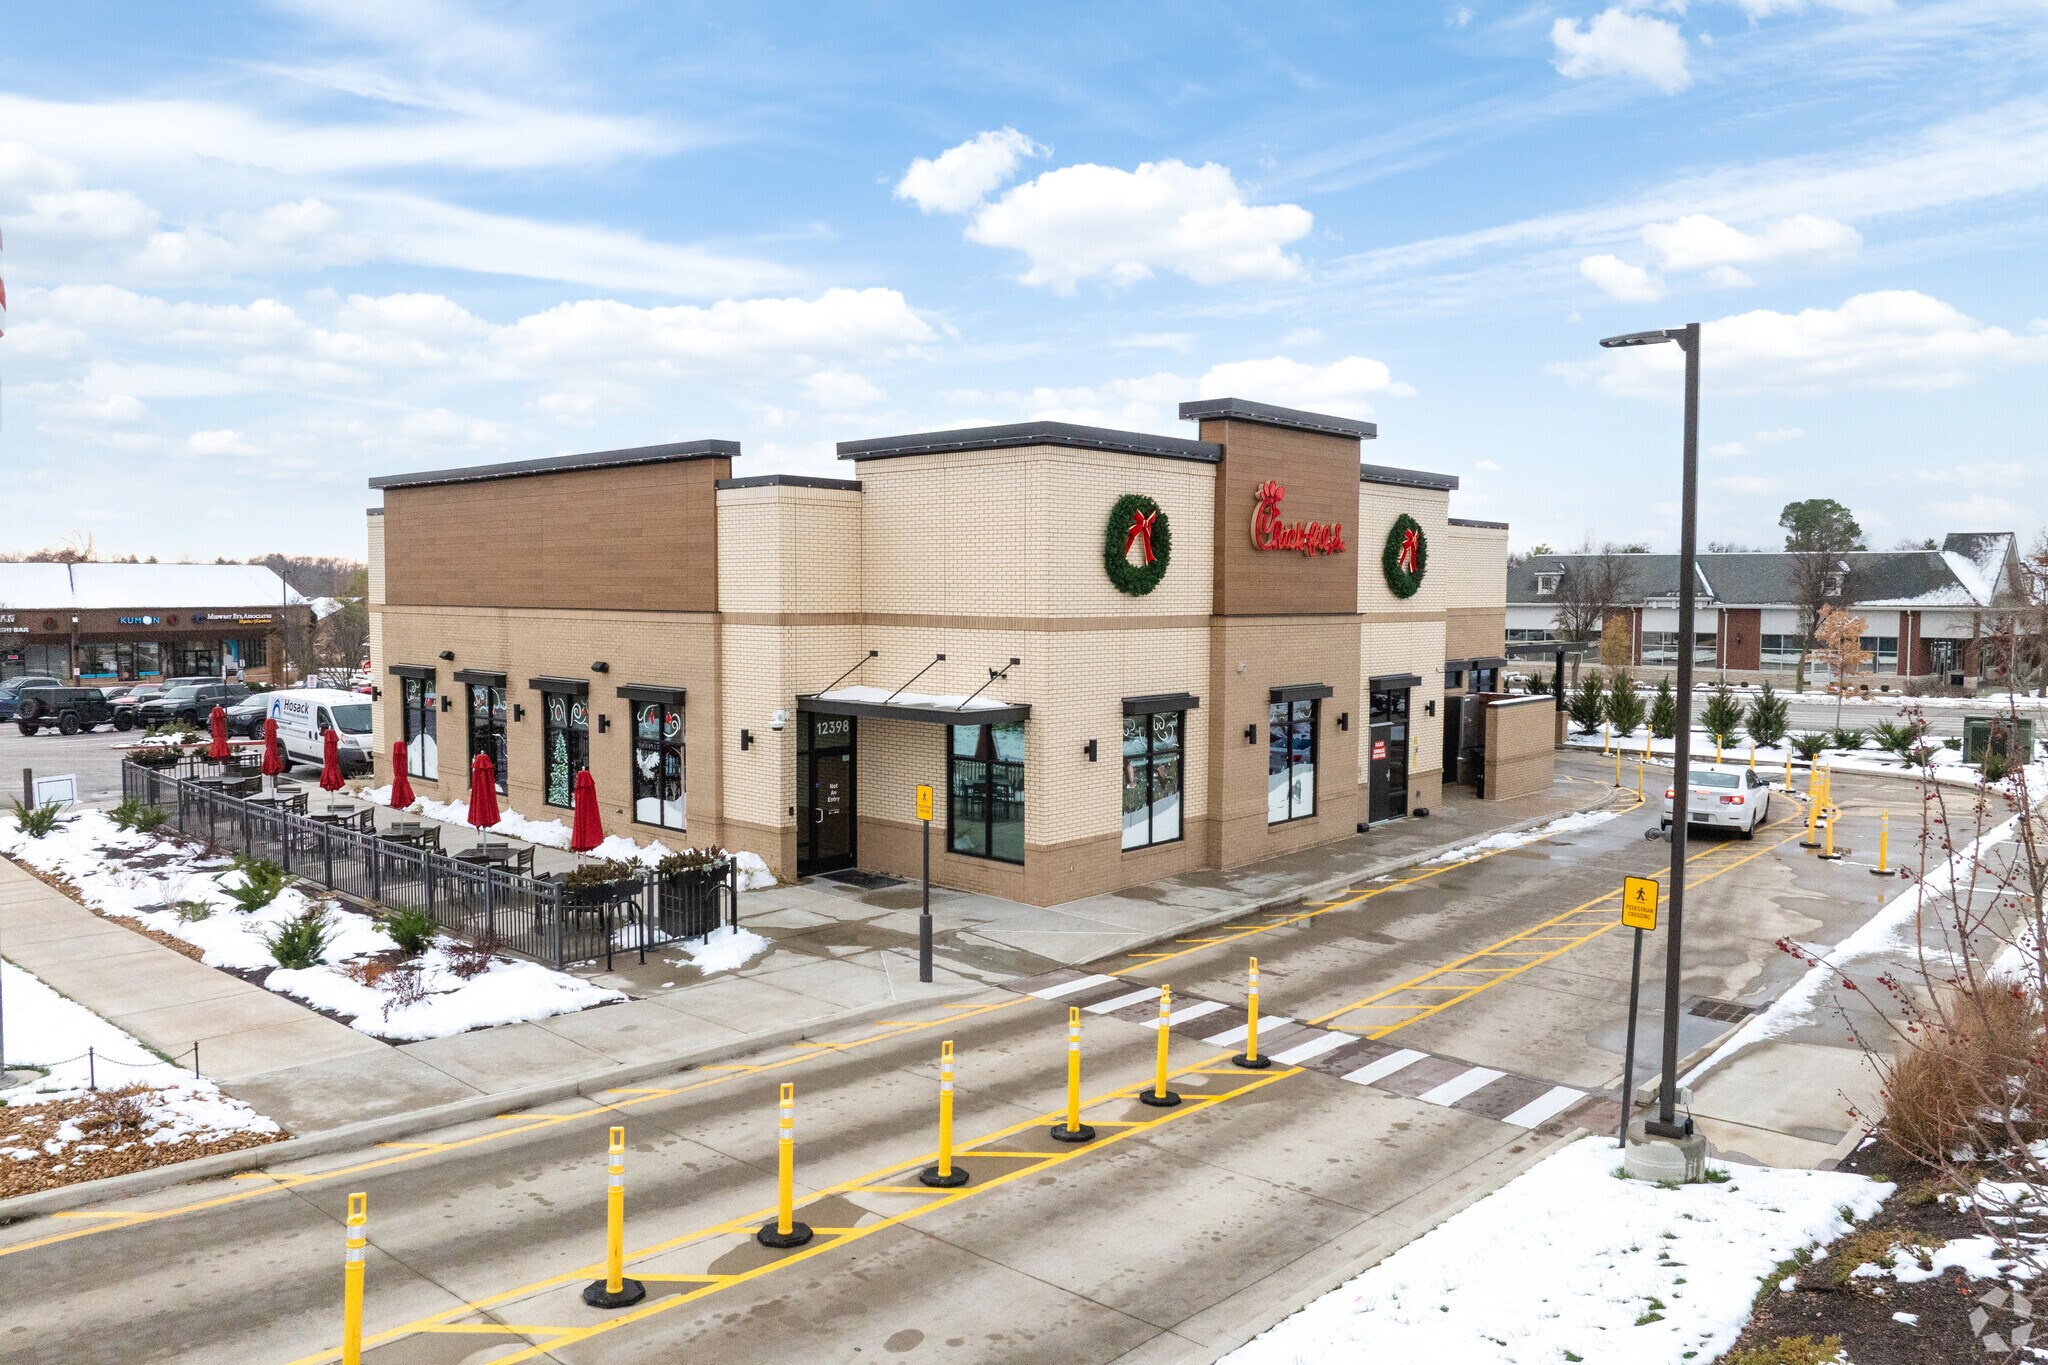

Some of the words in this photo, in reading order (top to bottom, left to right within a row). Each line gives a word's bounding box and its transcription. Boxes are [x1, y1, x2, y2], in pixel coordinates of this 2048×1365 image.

[1251, 480, 1346, 557] Chick-fil-A
[120, 616, 160, 625] KUMON
[283, 699, 309, 714] Hosack
[817, 720, 849, 735] 12398
[1626, 904, 1654, 914] PEDESTRIAN
[1627, 911, 1651, 920] CROSSING
